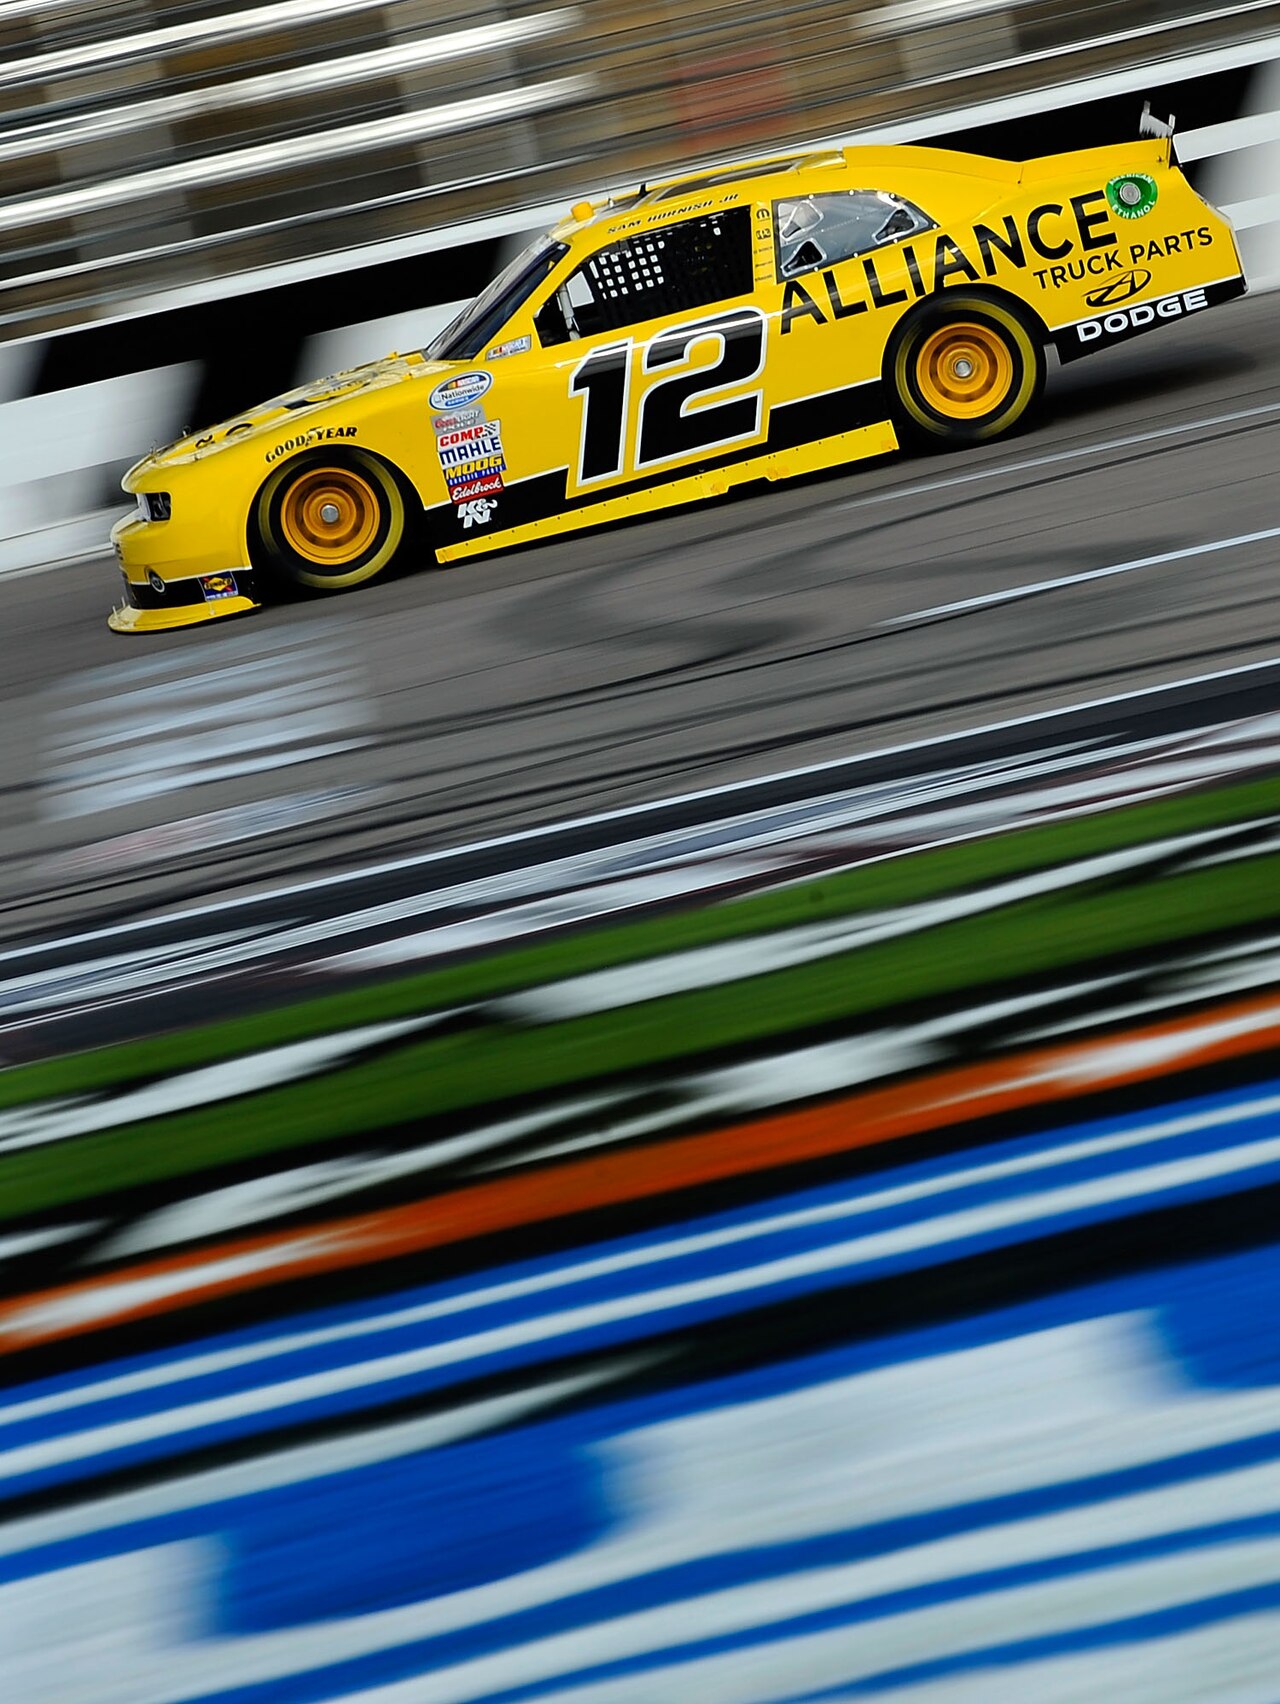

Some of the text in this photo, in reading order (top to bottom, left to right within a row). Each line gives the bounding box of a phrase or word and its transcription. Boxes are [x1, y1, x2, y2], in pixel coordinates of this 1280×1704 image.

[608, 193, 739, 234] SAM HORNISH JR
[1111, 200, 1155, 219] ETHANOL
[780, 190, 1118, 334] ALLIANCE
[1033, 226, 1213, 290] TRUCK PARTS
[1076, 288, 1209, 343] DODGE
[441, 385, 485, 401] Nationwide
[568, 306, 768, 487] 12
[265, 426, 358, 463] GOODYEAR
[440, 426, 484, 448] COMP
[440, 437, 502, 466] MAHLE
[446, 456, 502, 480] MOOG
[452, 477, 502, 501] Edelbrock
[457, 498, 498, 529] K&N
